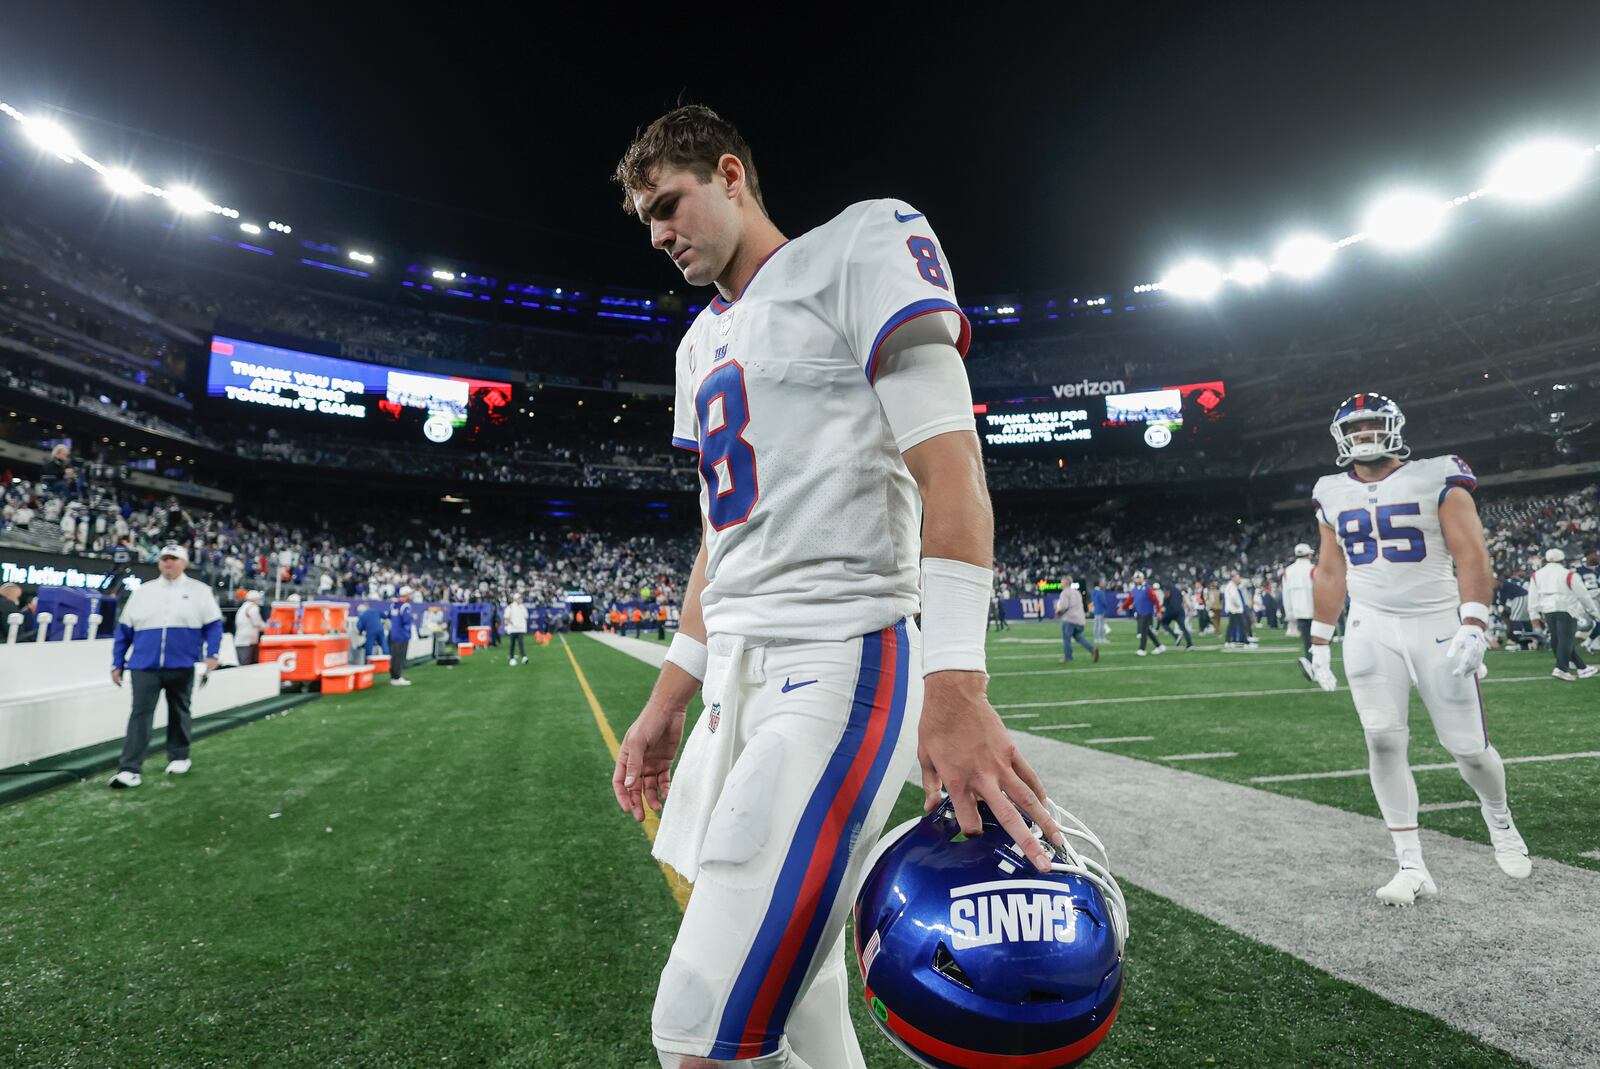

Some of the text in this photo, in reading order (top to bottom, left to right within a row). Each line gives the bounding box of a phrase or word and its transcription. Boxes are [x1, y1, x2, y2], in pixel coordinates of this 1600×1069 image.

[906, 235, 949, 291] 8
[230, 360, 365, 395] THANK YOU FOR
[1052, 378, 1126, 398] verizon
[249, 378, 346, 403] ATTDING
[318, 400, 365, 418] GAME
[986, 410, 1087, 426] THANK YOU FOR
[695, 359, 759, 532] 8
[1337, 502, 1427, 566] 85
[1, 562, 28, 584] The
[278, 651, 297, 672] G
[949, 893, 1077, 951] GIANTS
